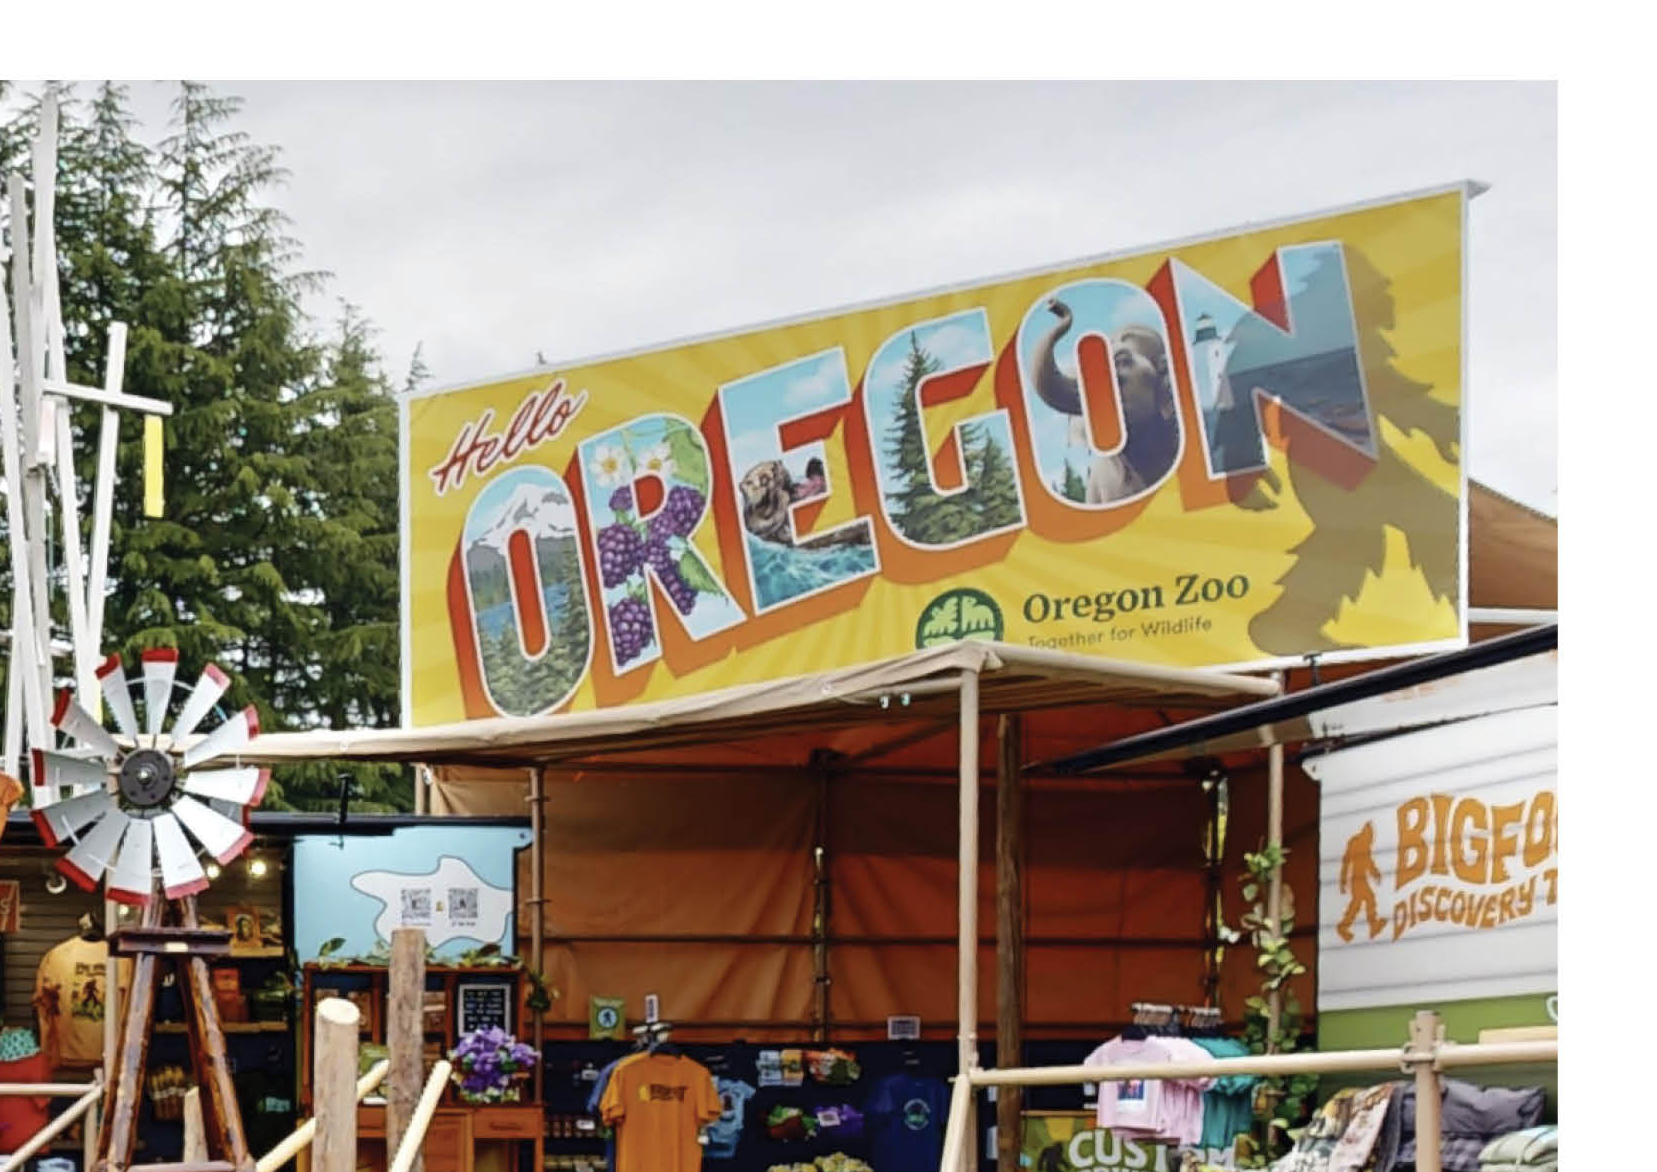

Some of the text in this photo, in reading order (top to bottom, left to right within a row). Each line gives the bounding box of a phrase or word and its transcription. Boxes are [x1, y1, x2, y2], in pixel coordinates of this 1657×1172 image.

[431, 381, 590, 495] Hello
[448, 240, 1379, 720] OREGON
[1023, 574, 1249, 624] Oregon Zoo
[1111, 625, 1136, 641] for
[1140, 615, 1212, 637] Wildlife
[1396, 791, 1558, 893] BIGFO
[1392, 877, 1538, 943] DISCOVERY
